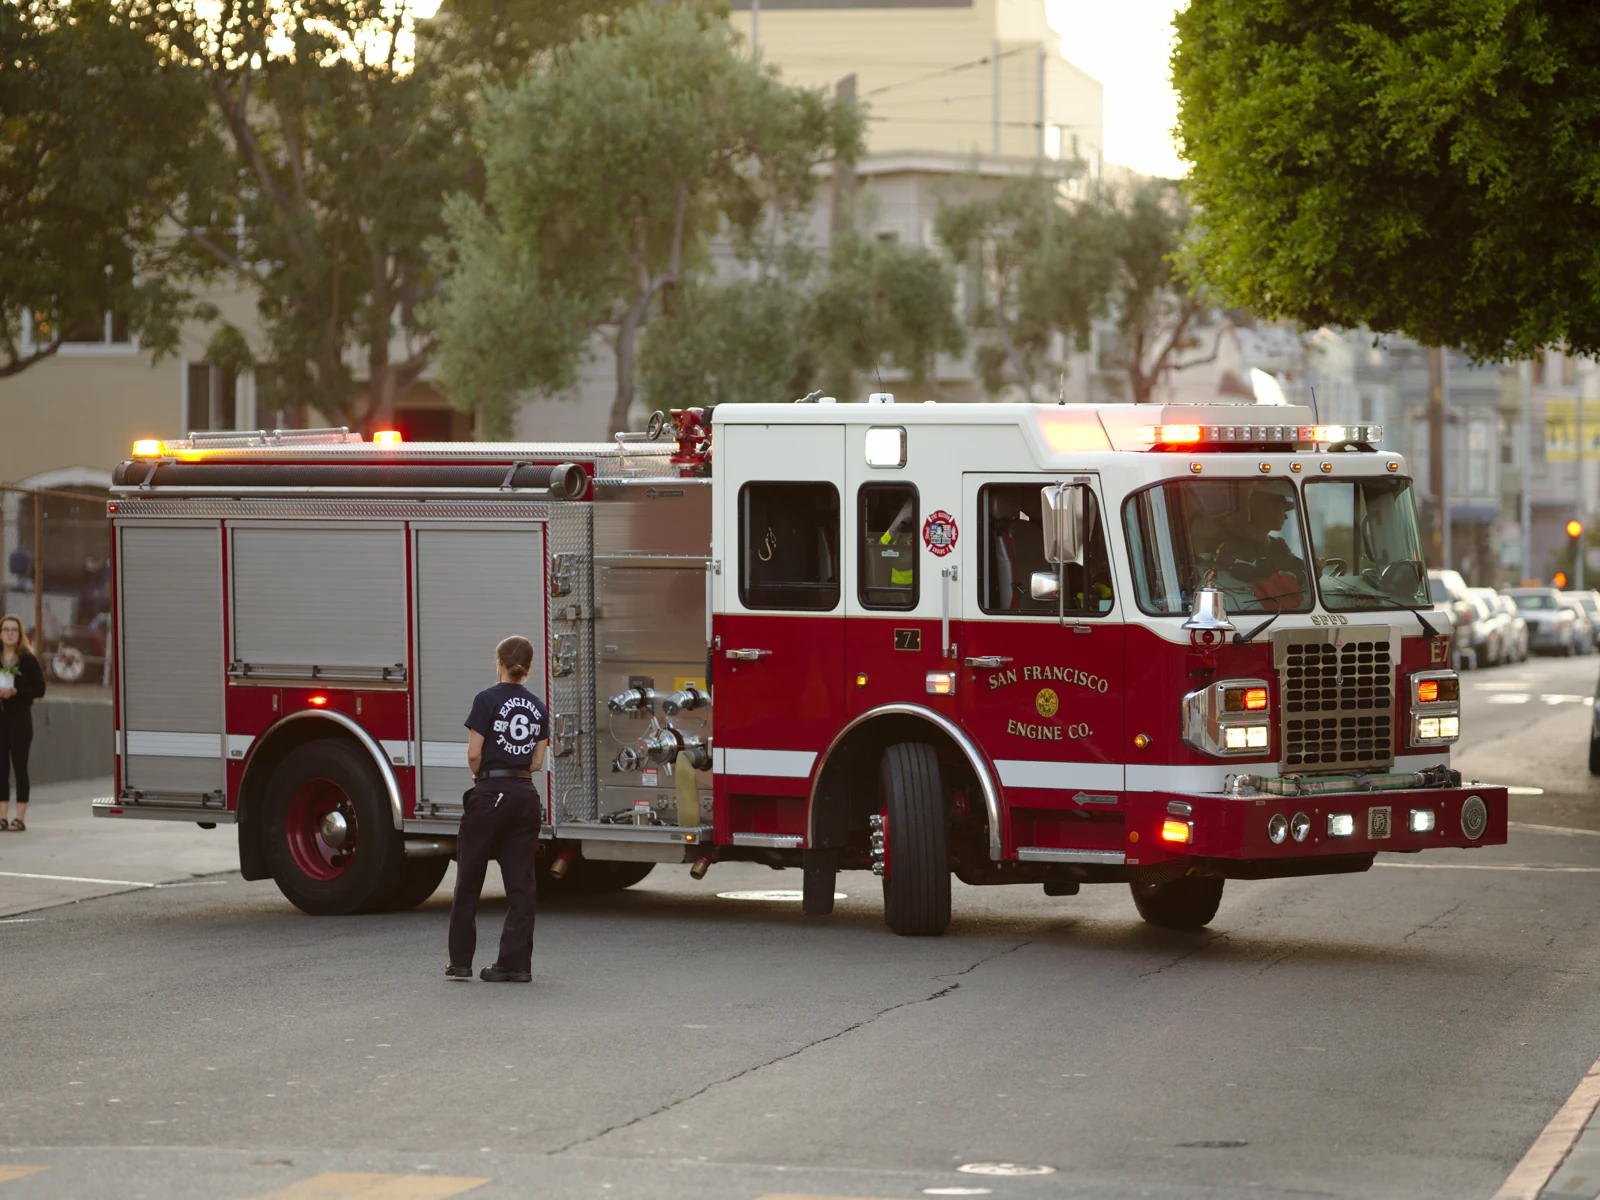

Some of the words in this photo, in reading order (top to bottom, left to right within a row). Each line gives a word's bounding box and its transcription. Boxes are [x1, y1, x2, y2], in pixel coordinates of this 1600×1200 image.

[903, 631, 911, 648] 7
[1430, 640, 1450, 663] E7
[988, 668, 1017, 690] SAN
[1023, 665, 1109, 693] FRANCISCO
[499, 697, 541, 720] ENGINE
[509, 714, 529, 740] 6
[1006, 719, 1062, 740] ENGINE
[1068, 722, 1094, 739] CO.
[496, 734, 537, 755] TRUCK
